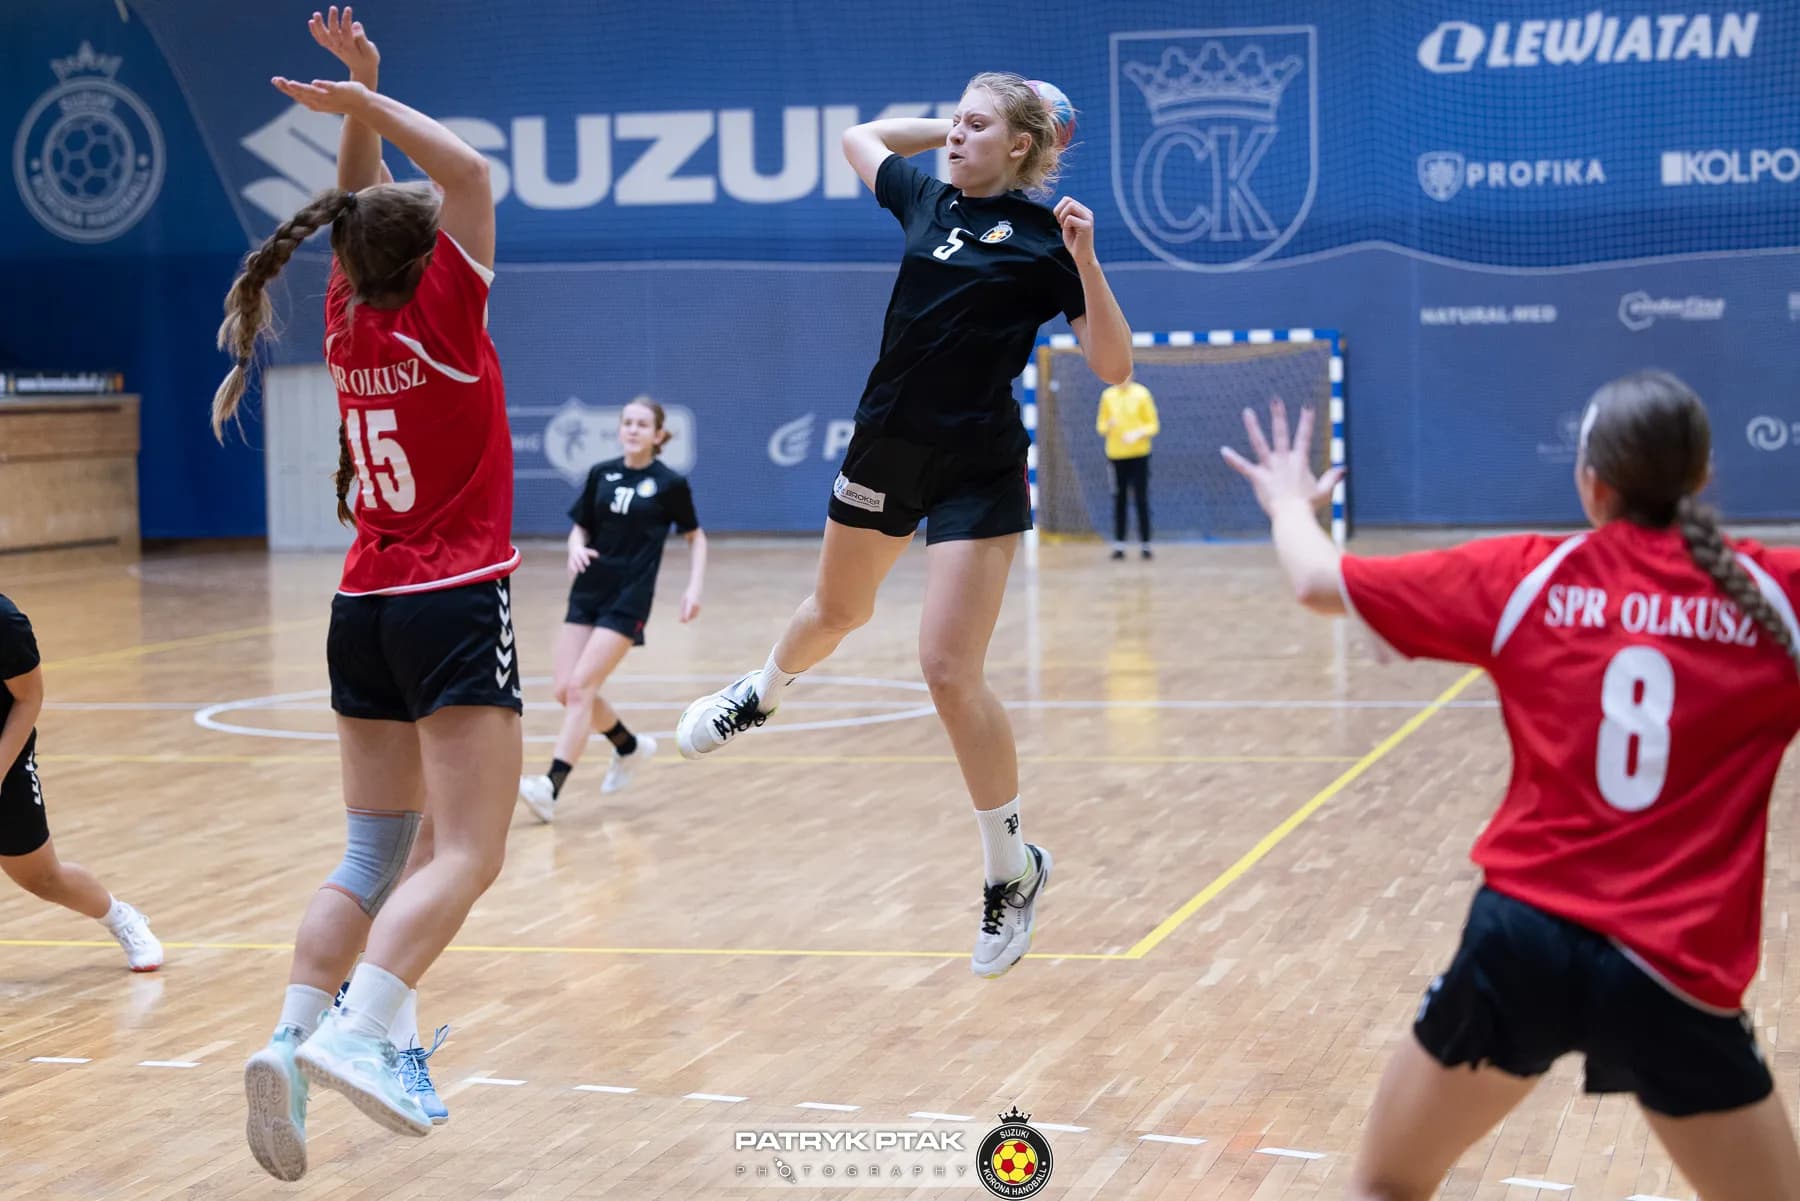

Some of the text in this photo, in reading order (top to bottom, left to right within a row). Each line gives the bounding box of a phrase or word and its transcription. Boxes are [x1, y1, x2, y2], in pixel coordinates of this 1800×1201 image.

[1488, 11, 1759, 67] LEWIATAN
[1133, 124, 1282, 244] CK
[1465, 158, 1607, 190] PROFIKA
[1684, 148, 1800, 185] KOLPO
[932, 226, 976, 261] 5
[350, 358, 427, 396] OLKUSZ
[346, 408, 416, 513] 15
[610, 486, 635, 514] 31
[846, 489, 881, 505] BROKER
[1544, 584, 1758, 647] SPR OLKUSZ
[1595, 646, 1676, 812] 8
